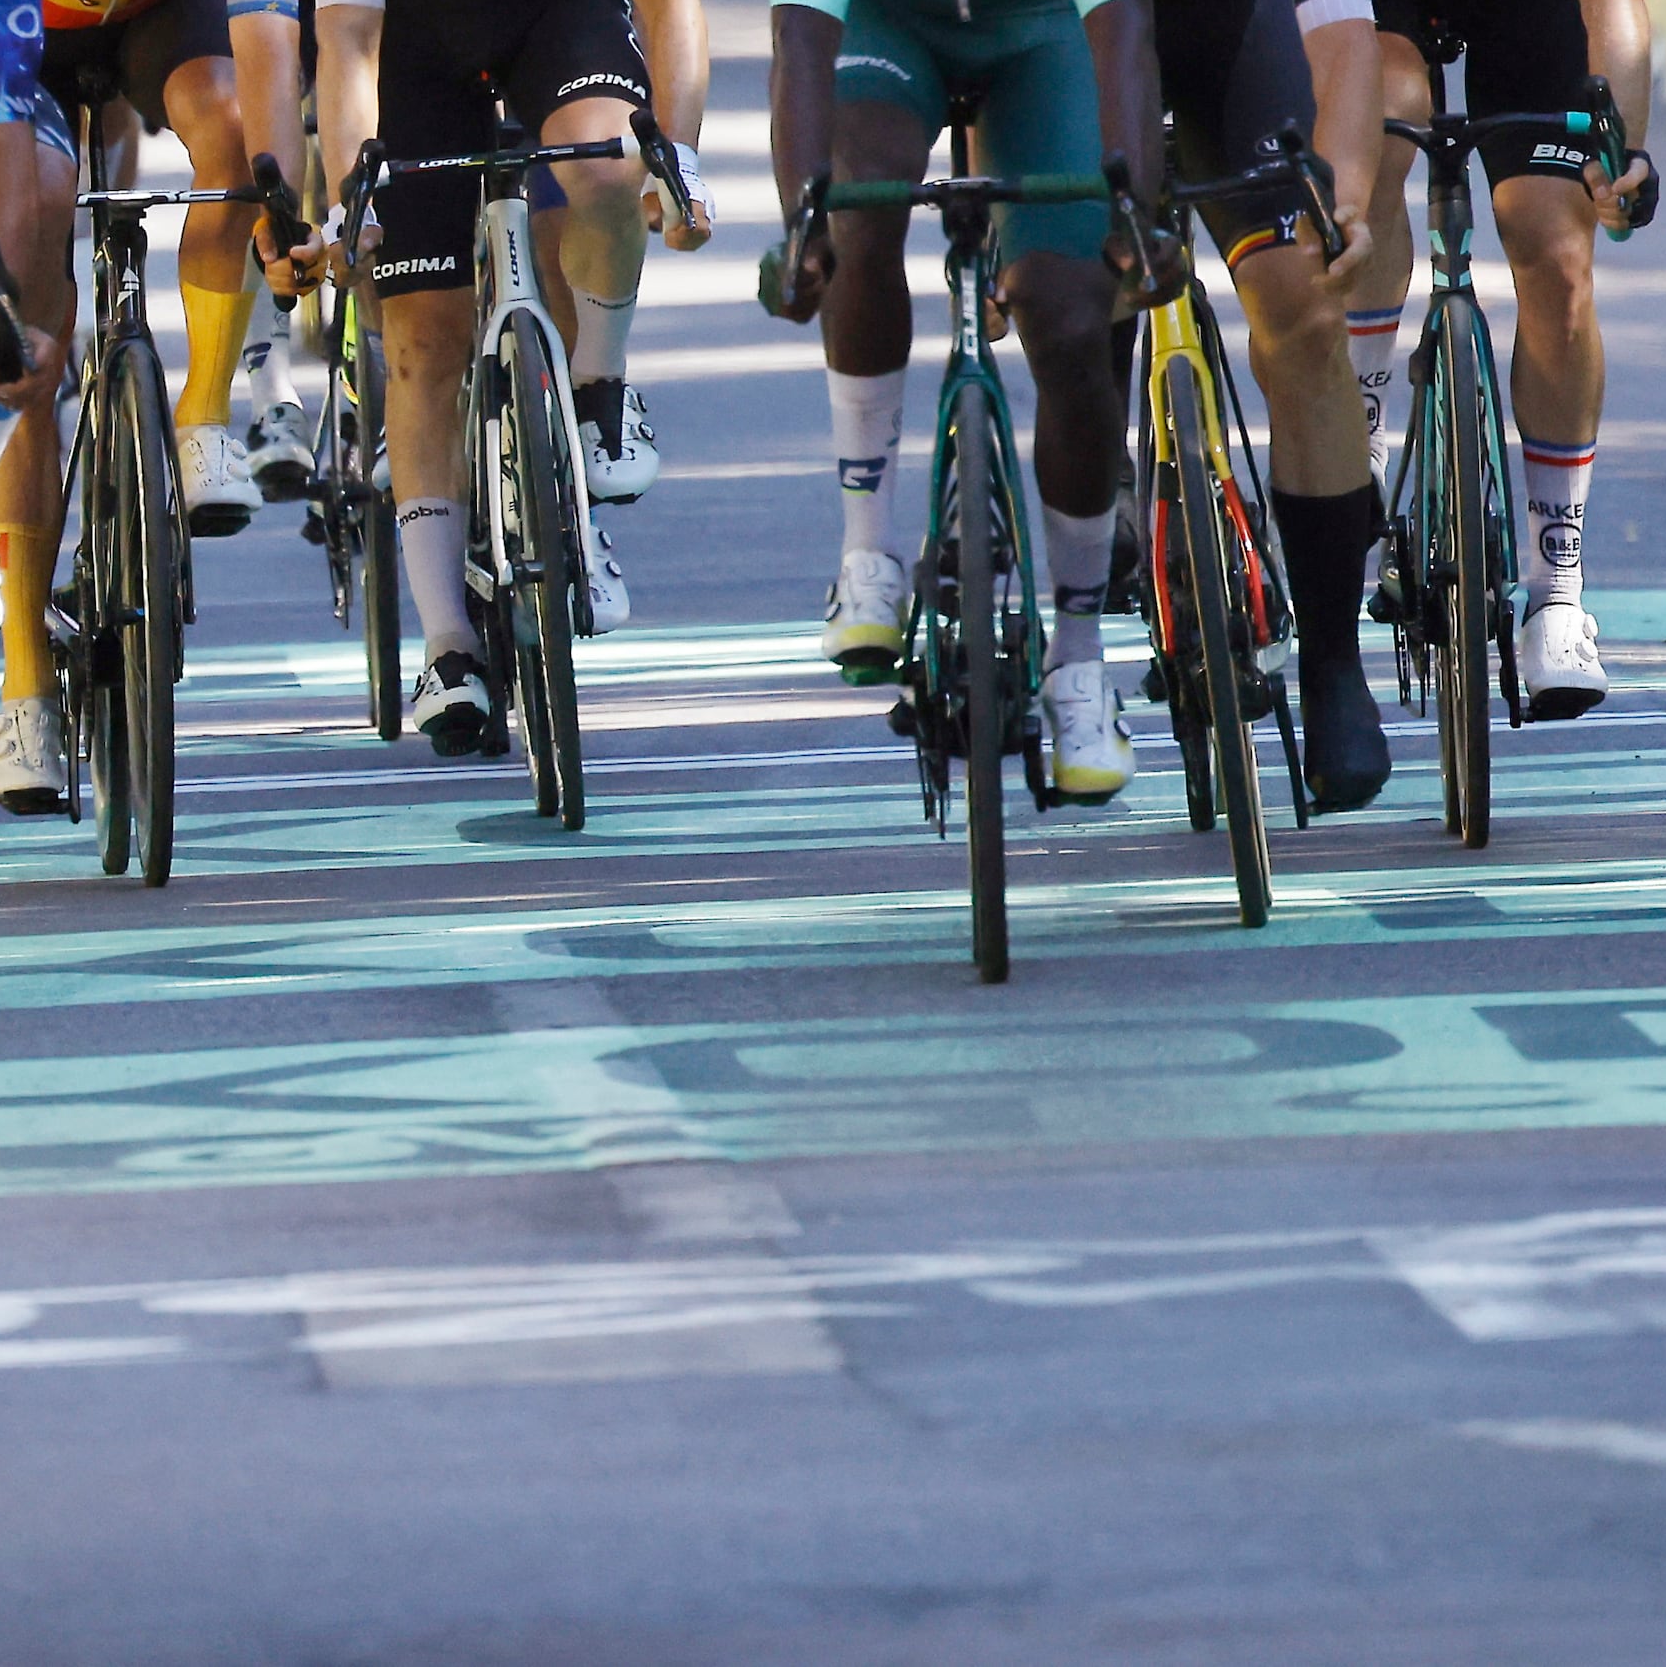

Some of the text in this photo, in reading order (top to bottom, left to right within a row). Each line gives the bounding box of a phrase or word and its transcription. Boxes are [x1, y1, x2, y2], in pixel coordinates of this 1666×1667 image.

[557, 72, 647, 100] CORIMA
[418, 156, 472, 169] LOOK
[372, 255, 456, 280] CORIMA
[506, 228, 521, 288] LOOK
